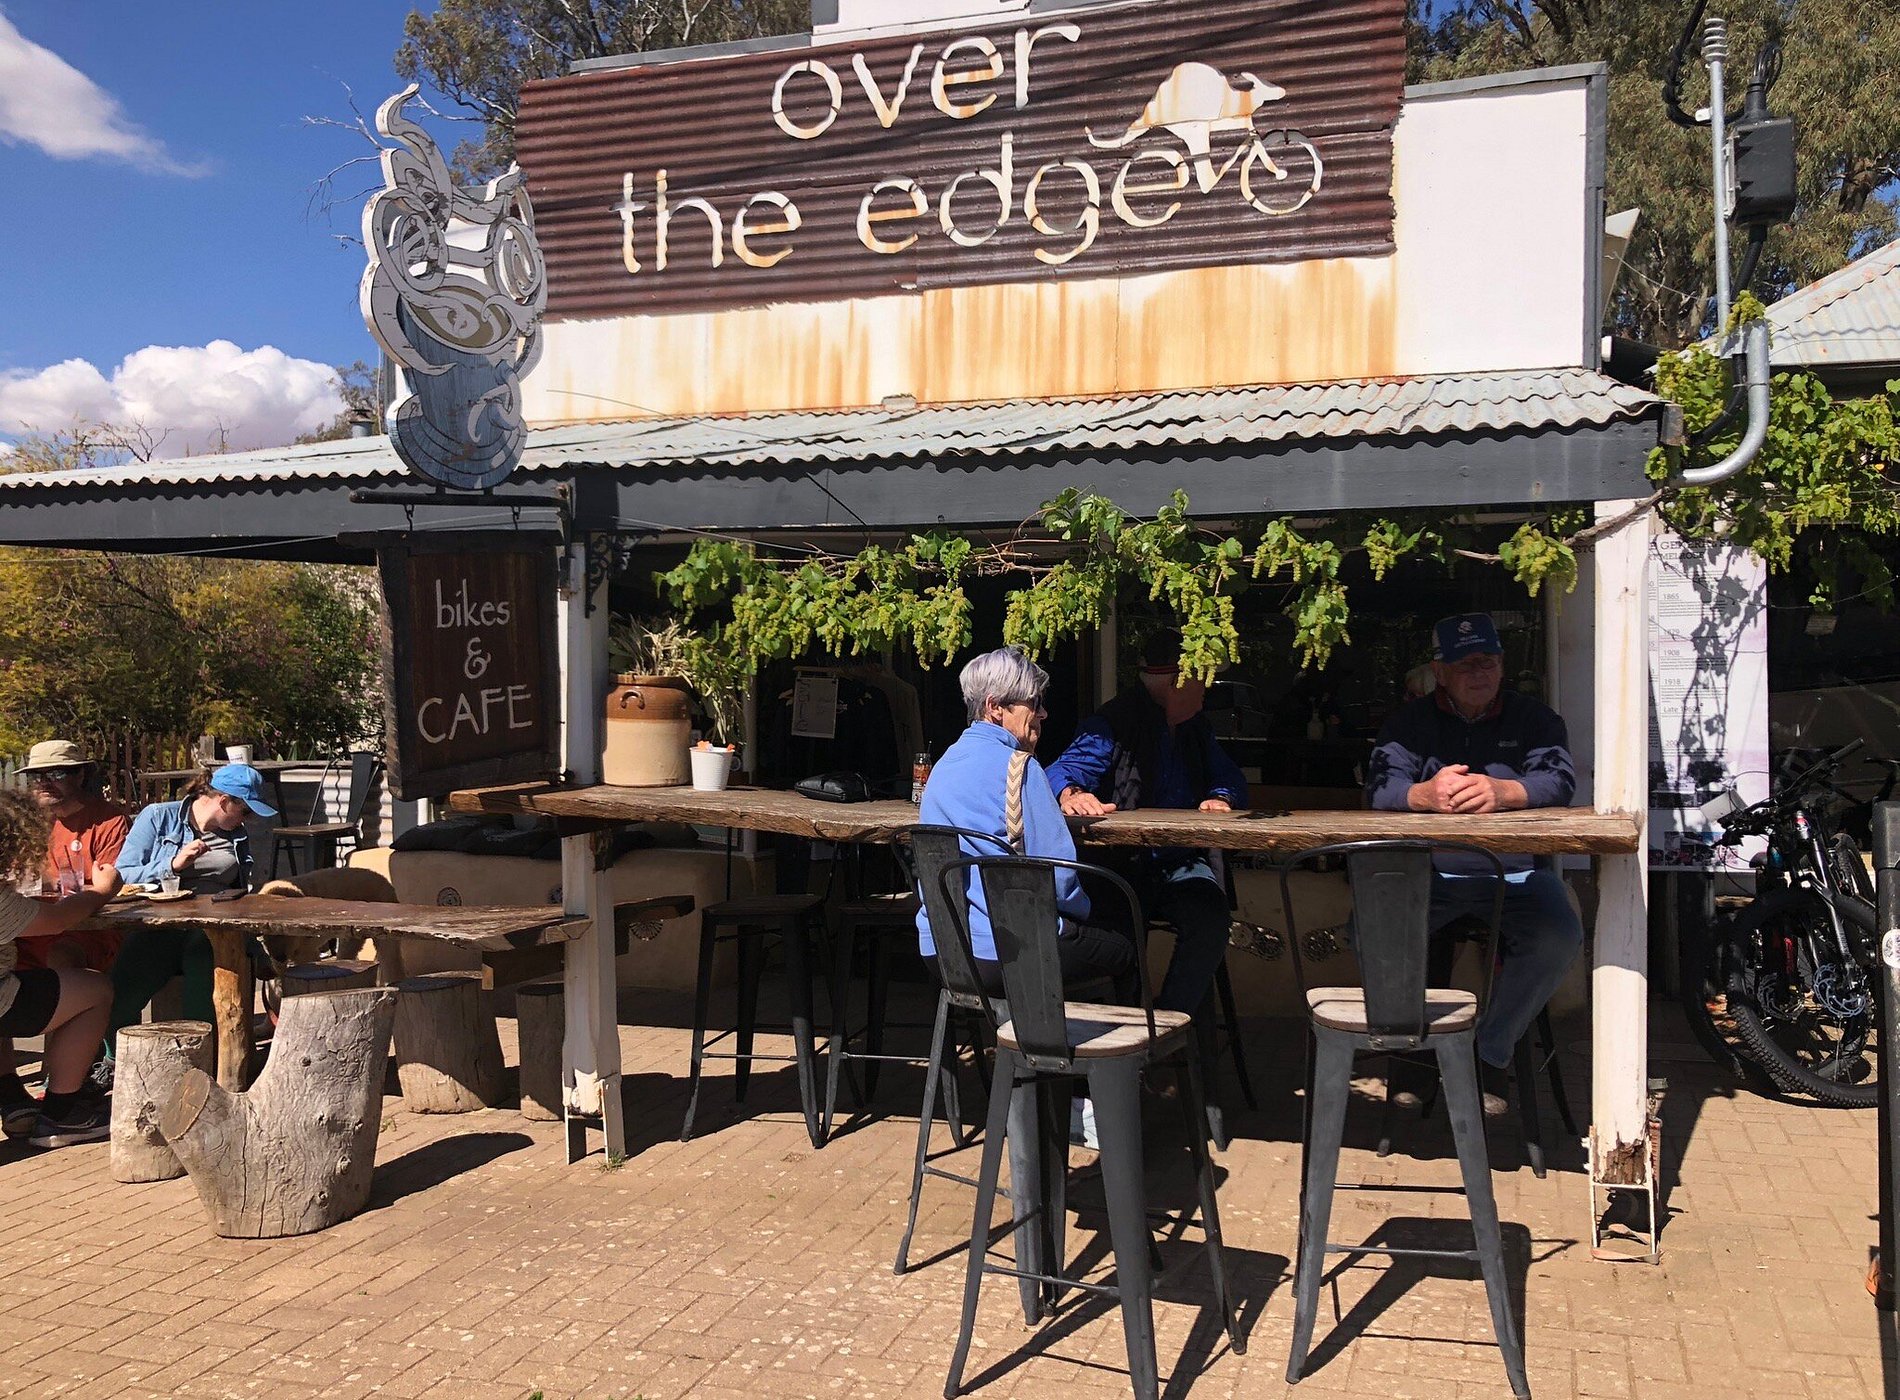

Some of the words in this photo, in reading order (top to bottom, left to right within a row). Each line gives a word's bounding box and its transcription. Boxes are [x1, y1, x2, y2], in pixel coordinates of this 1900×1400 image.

[771, 22, 1081, 140] over
[611, 168, 803, 274] the
[855, 131, 1191, 266] edge
[435, 578, 511, 629] bikes
[464, 636, 491, 680] &
[417, 683, 533, 744] CAFE
